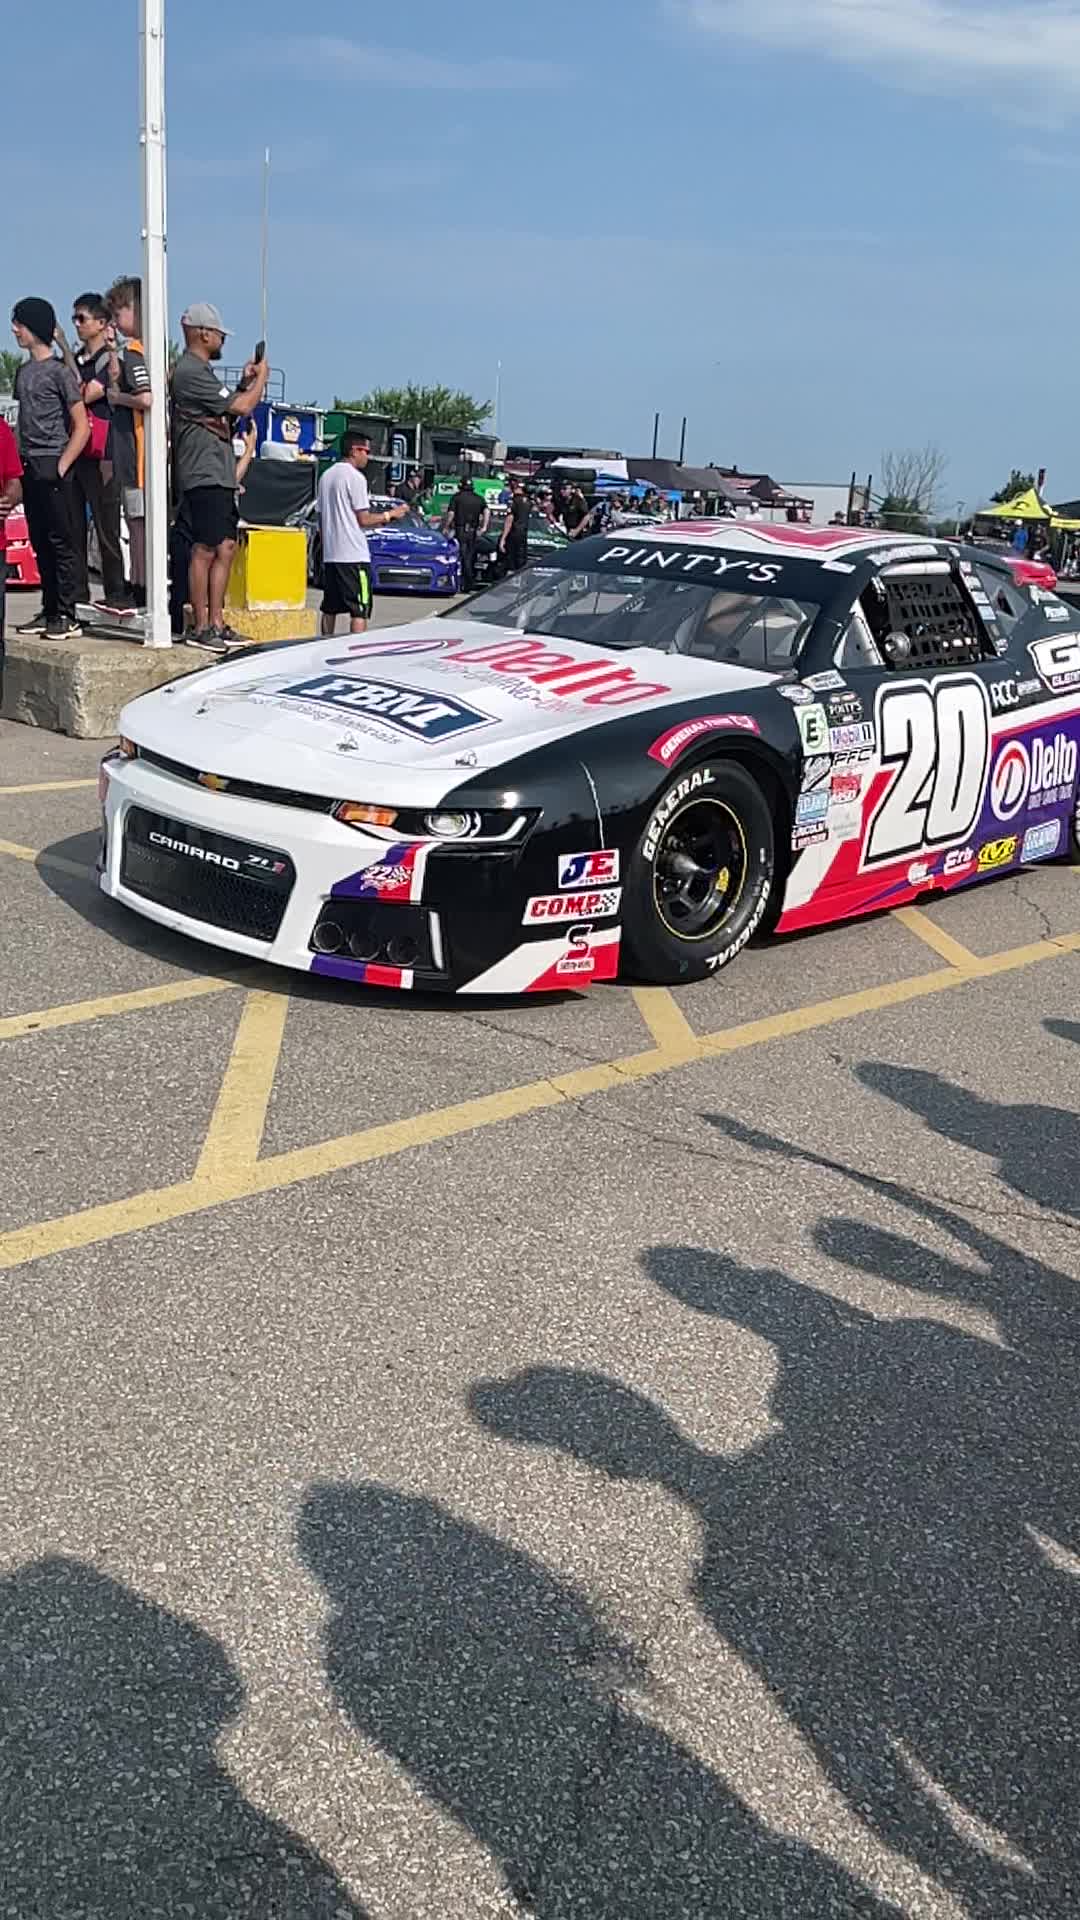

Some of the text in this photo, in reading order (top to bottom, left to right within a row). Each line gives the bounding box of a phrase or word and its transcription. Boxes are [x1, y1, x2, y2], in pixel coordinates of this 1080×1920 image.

[300, 678, 461, 728] FBM
[660, 721, 707, 760] GENERAL
[863, 678, 989, 867] 20
[642, 768, 717, 862] GENERAL
[148, 831, 241, 871] CAMARO
[560, 852, 615, 886] JE
[530, 893, 602, 918] COMP
[704, 879, 771, 970] GENERAL
